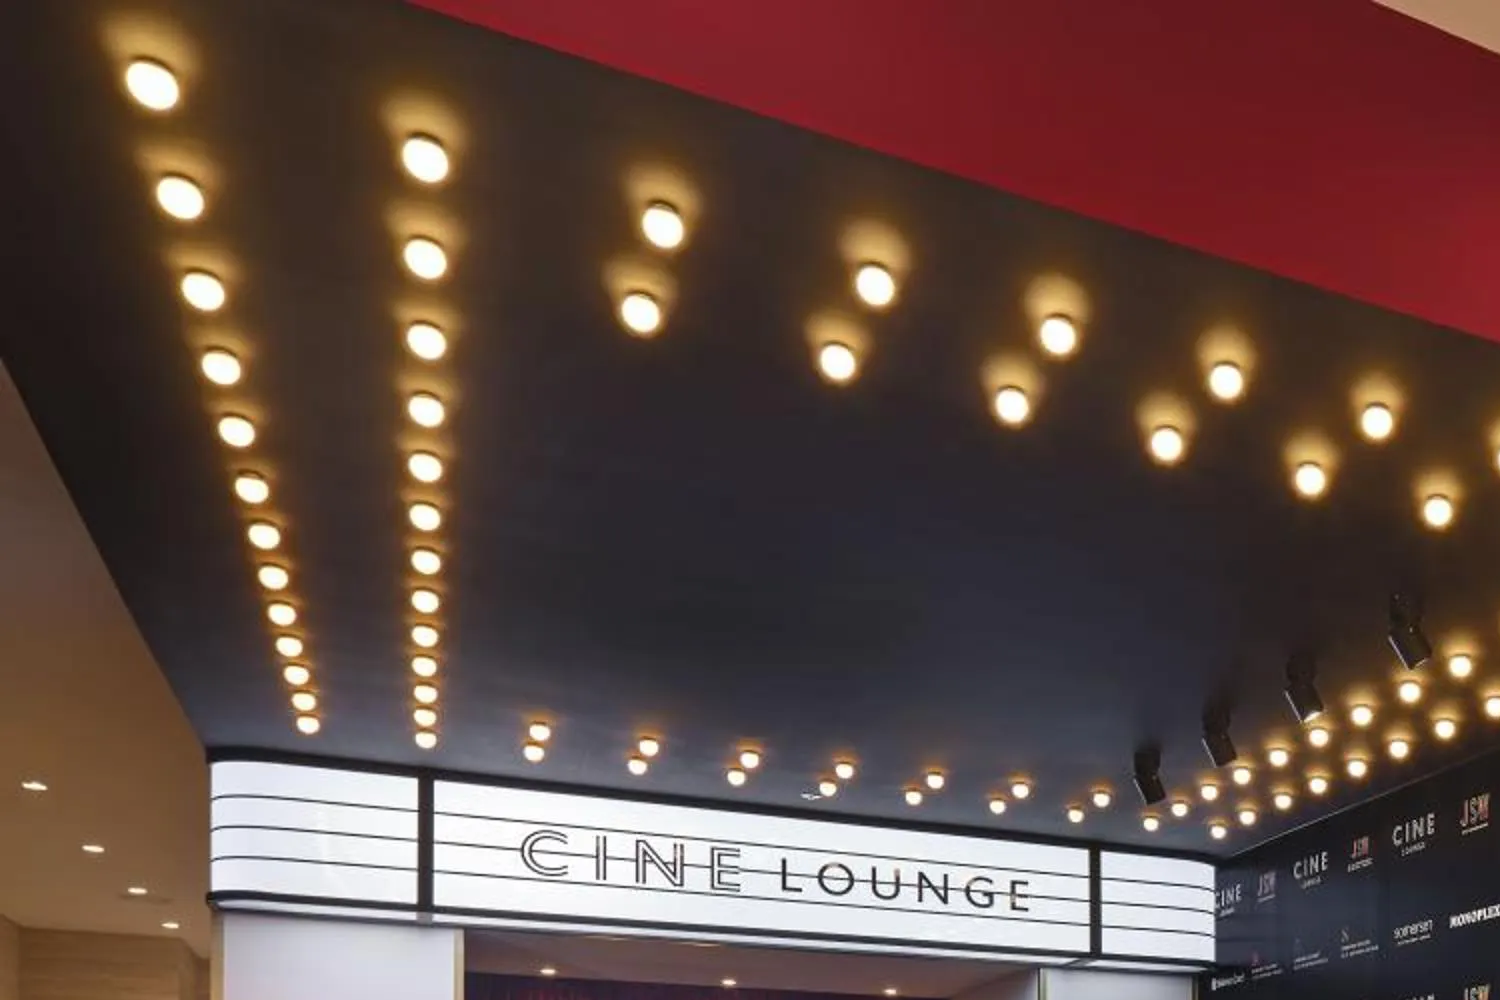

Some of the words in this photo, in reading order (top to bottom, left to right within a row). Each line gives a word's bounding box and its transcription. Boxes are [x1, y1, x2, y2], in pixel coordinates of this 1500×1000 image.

[1391, 812, 1434, 846] CINE
[521, 828, 743, 894] CINE
[779, 862, 1033, 911] LOUNGE
[1293, 850, 1327, 880] CINE
[1449, 903, 1500, 928] MONOPLEX
